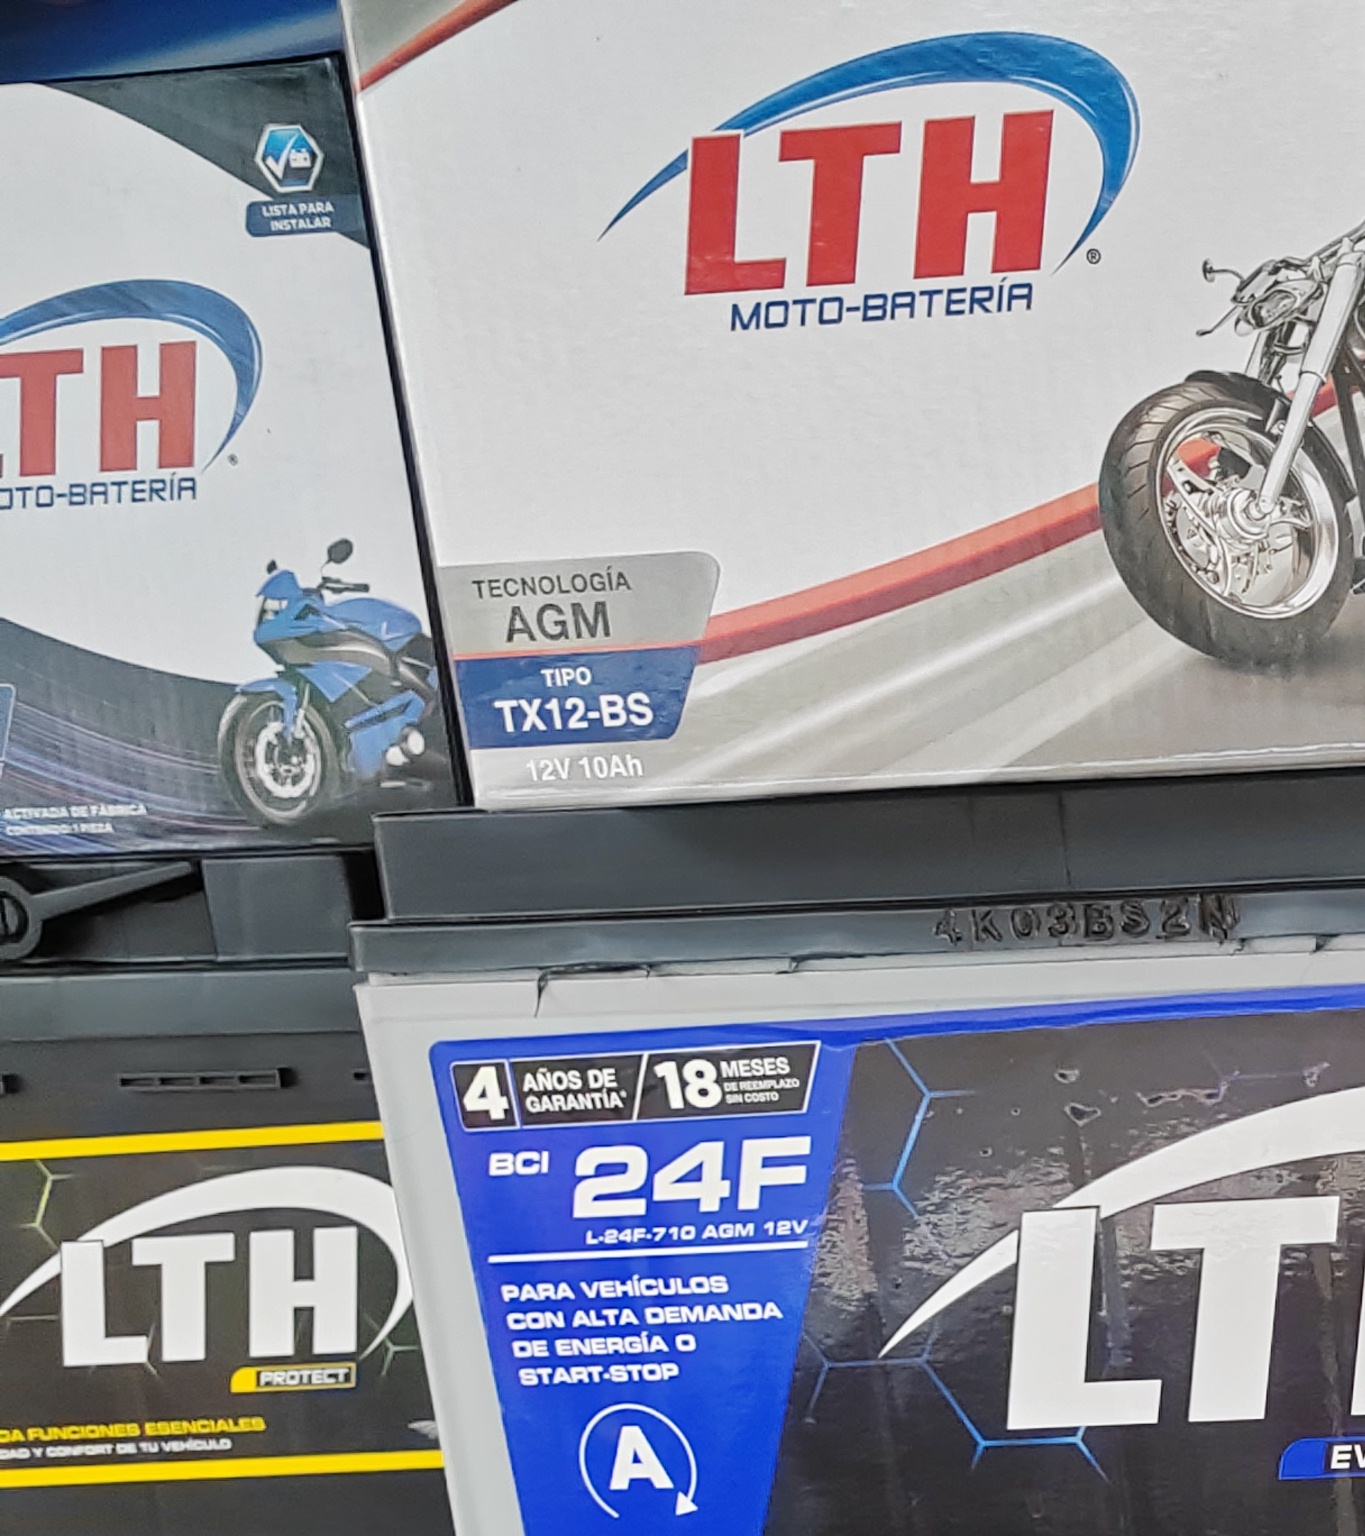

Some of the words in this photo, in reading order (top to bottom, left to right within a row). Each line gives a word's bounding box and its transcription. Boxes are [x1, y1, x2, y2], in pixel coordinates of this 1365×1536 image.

[262, 203, 297, 217] LISTA
[299, 202, 334, 214] PARA
[685, 109, 1054, 295] LTH
[270, 217, 331, 231] INSTALAR
[730, 277, 1033, 331] MOTO-BATERÍA
[0, 341, 196, 478] TH
[0, 472, 196, 510] OTO-BATERÍA
[472, 566, 631, 599] TECNOLOGÍA
[506, 601, 611, 642] AGM
[541, 667, 591, 687] TIPO
[494, 692, 653, 733] TX12-BS
[526, 757, 569, 782] 12V
[580, 754, 643, 779] 10Ah
[463, 1067, 509, 1120] 4
[523, 1069, 582, 1092] AÑOS
[588, 1069, 617, 1088] DE
[654, 1059, 722, 1110] 18
[720, 1057, 790, 1078] MESES
[724, 1082, 739, 1092] DE
[740, 1078, 799, 1091] REEMPLAZO
[725, 1093, 744, 1103] SIN
[745, 1091, 779, 1102] COSTO
[489, 1151, 549, 1176] BCI
[573, 1136, 811, 1218] 24F
[702, 1223, 754, 1240] AGM
[764, 1220, 808, 1235] 12V
[61, 1226, 358, 1367] LTH
[501, 1281, 574, 1302] PARA
[580, 1273, 728, 1298] VEHÍCULOS
[507, 1312, 565, 1331] CON
[572, 1308, 639, 1327] ALTA
[645, 1302, 783, 1325] DEMANDA
[512, 1340, 549, 1358] DE
[556, 1332, 668, 1356] ENERGÍA
[675, 1335, 696, 1351] O
[259, 1368, 349, 1386] PROTECT
[519, 1364, 679, 1386] START-STOP
[27, 1423, 140, 1441] FUNCIONES
[144, 1417, 266, 1436] ESENCIALES
[139, 1442, 158, 1452] TU
[610, 1425, 674, 1490] A
